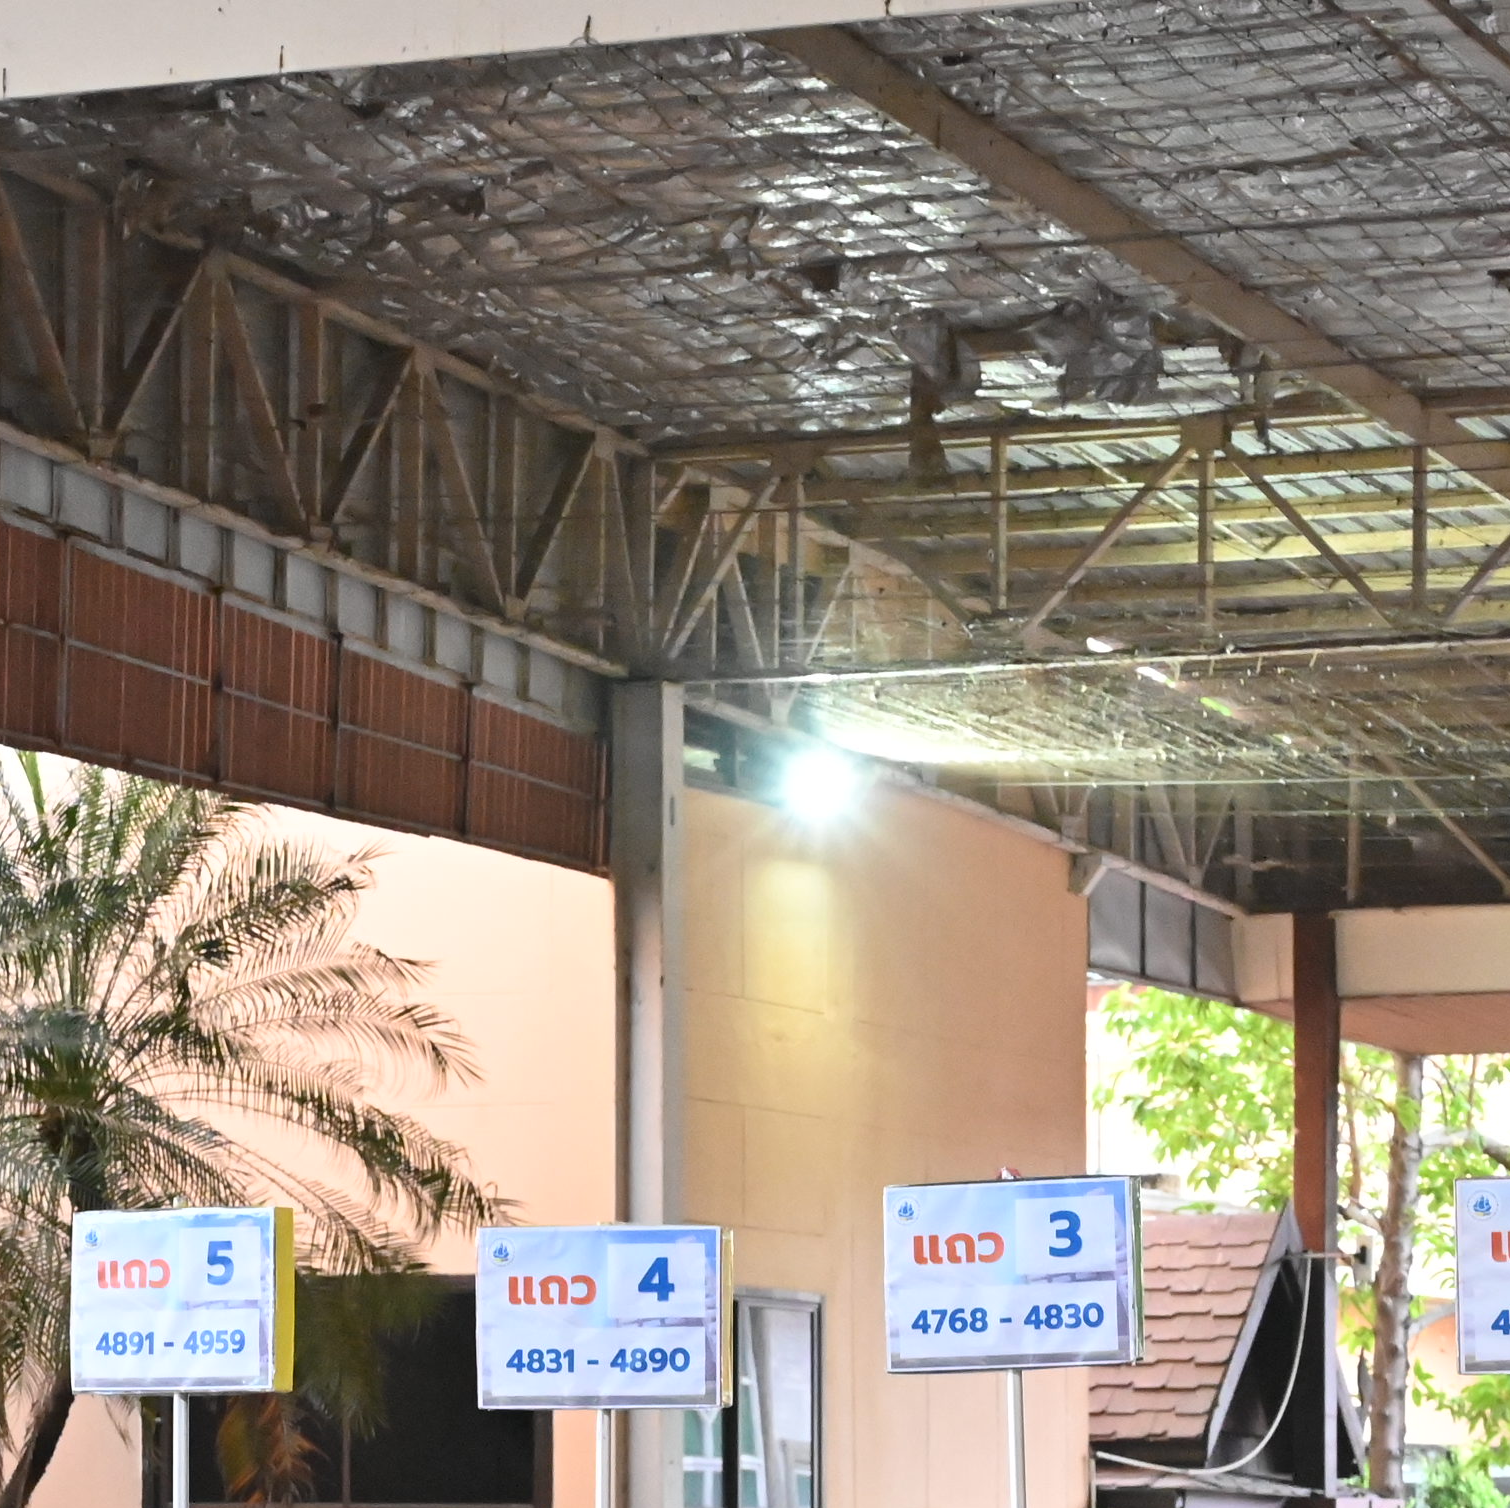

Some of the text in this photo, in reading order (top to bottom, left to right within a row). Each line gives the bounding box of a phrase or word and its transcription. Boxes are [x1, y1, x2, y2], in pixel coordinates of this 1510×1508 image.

[913, 1208, 1085, 1265] แถว 3
[96, 1240, 235, 1291] แถว 5
[508, 1256, 677, 1305] แถว 4
[910, 1307, 989, 1336] 4768
[1022, 1301, 1105, 1332] 4830
[95, 1330, 155, 1356] 4891
[182, 1328, 246, 1356] 4959
[505, 1347, 576, 1374] 4831
[609, 1346, 692, 1374] 4890
